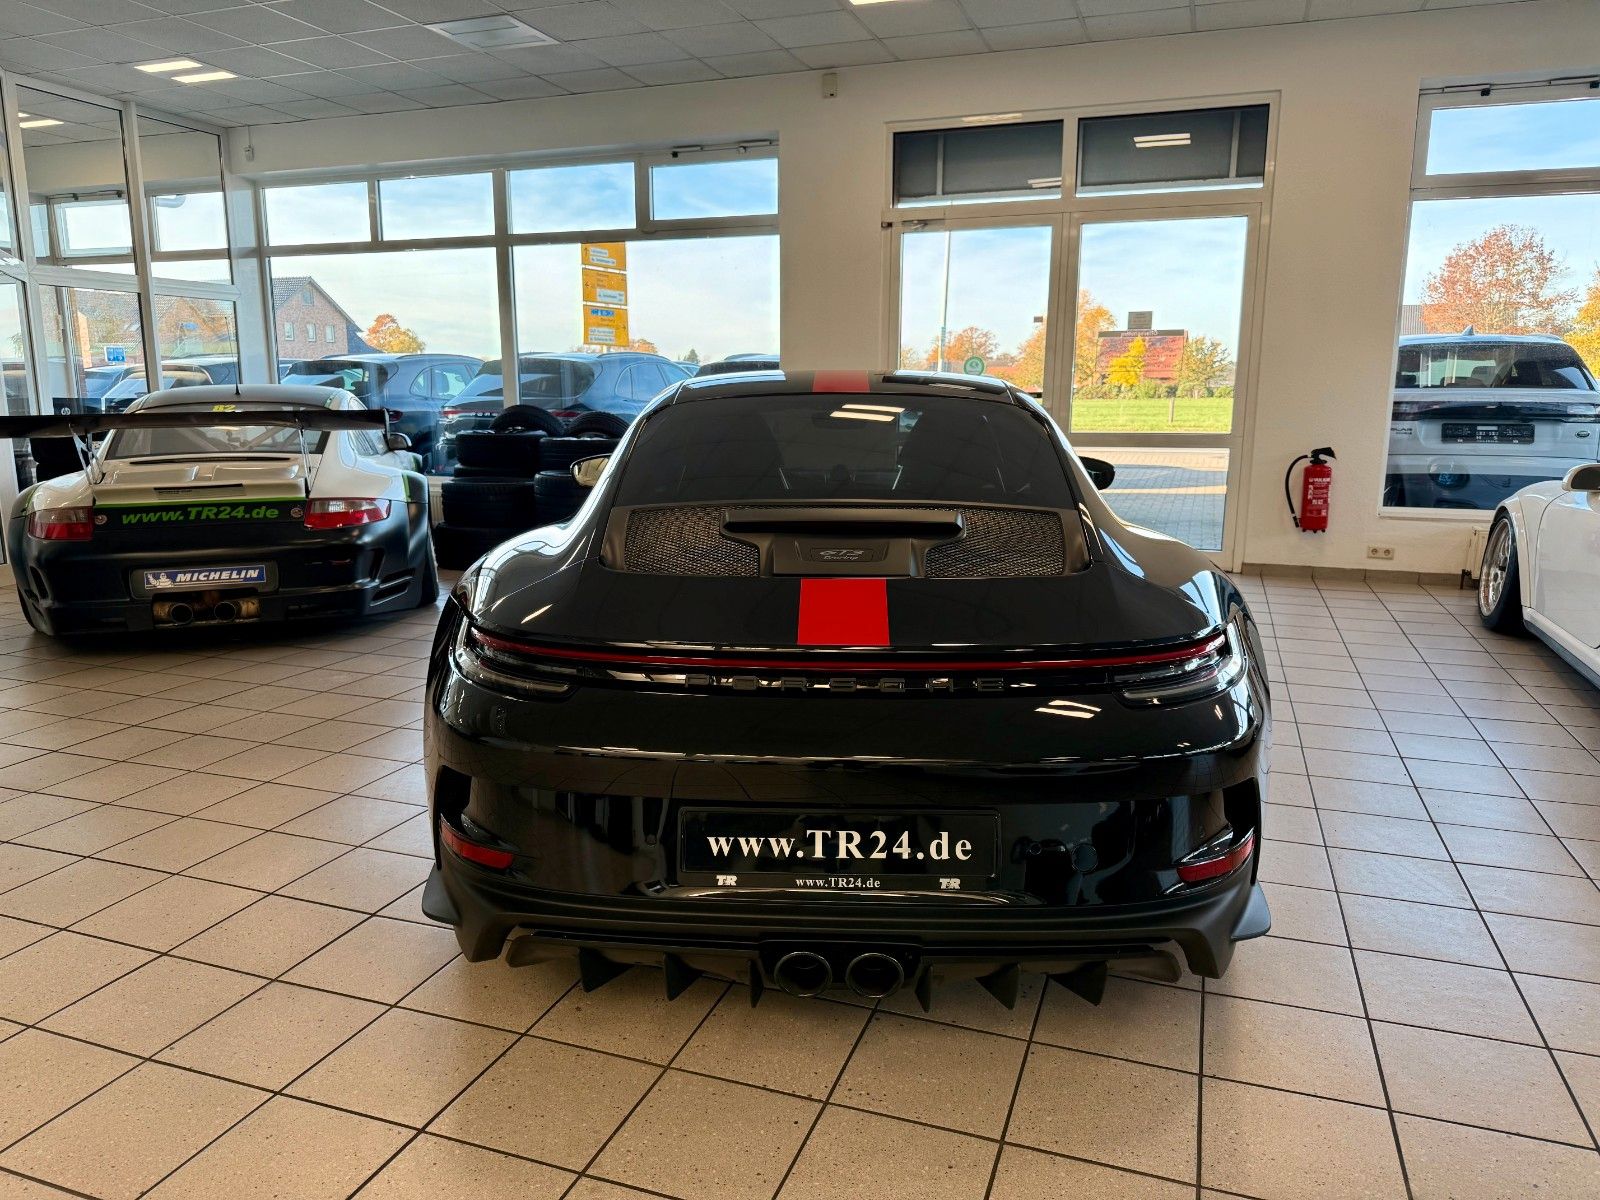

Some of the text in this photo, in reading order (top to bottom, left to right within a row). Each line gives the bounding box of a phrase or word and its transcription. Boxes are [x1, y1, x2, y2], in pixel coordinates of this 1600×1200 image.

[123, 506, 279, 524] www.TR24.de
[175, 569, 260, 582] MICHELIN
[685, 673, 1005, 693] PORSCHE
[706, 829, 973, 861] www.TR24.de
[795, 876, 881, 889] www.TR24.de
